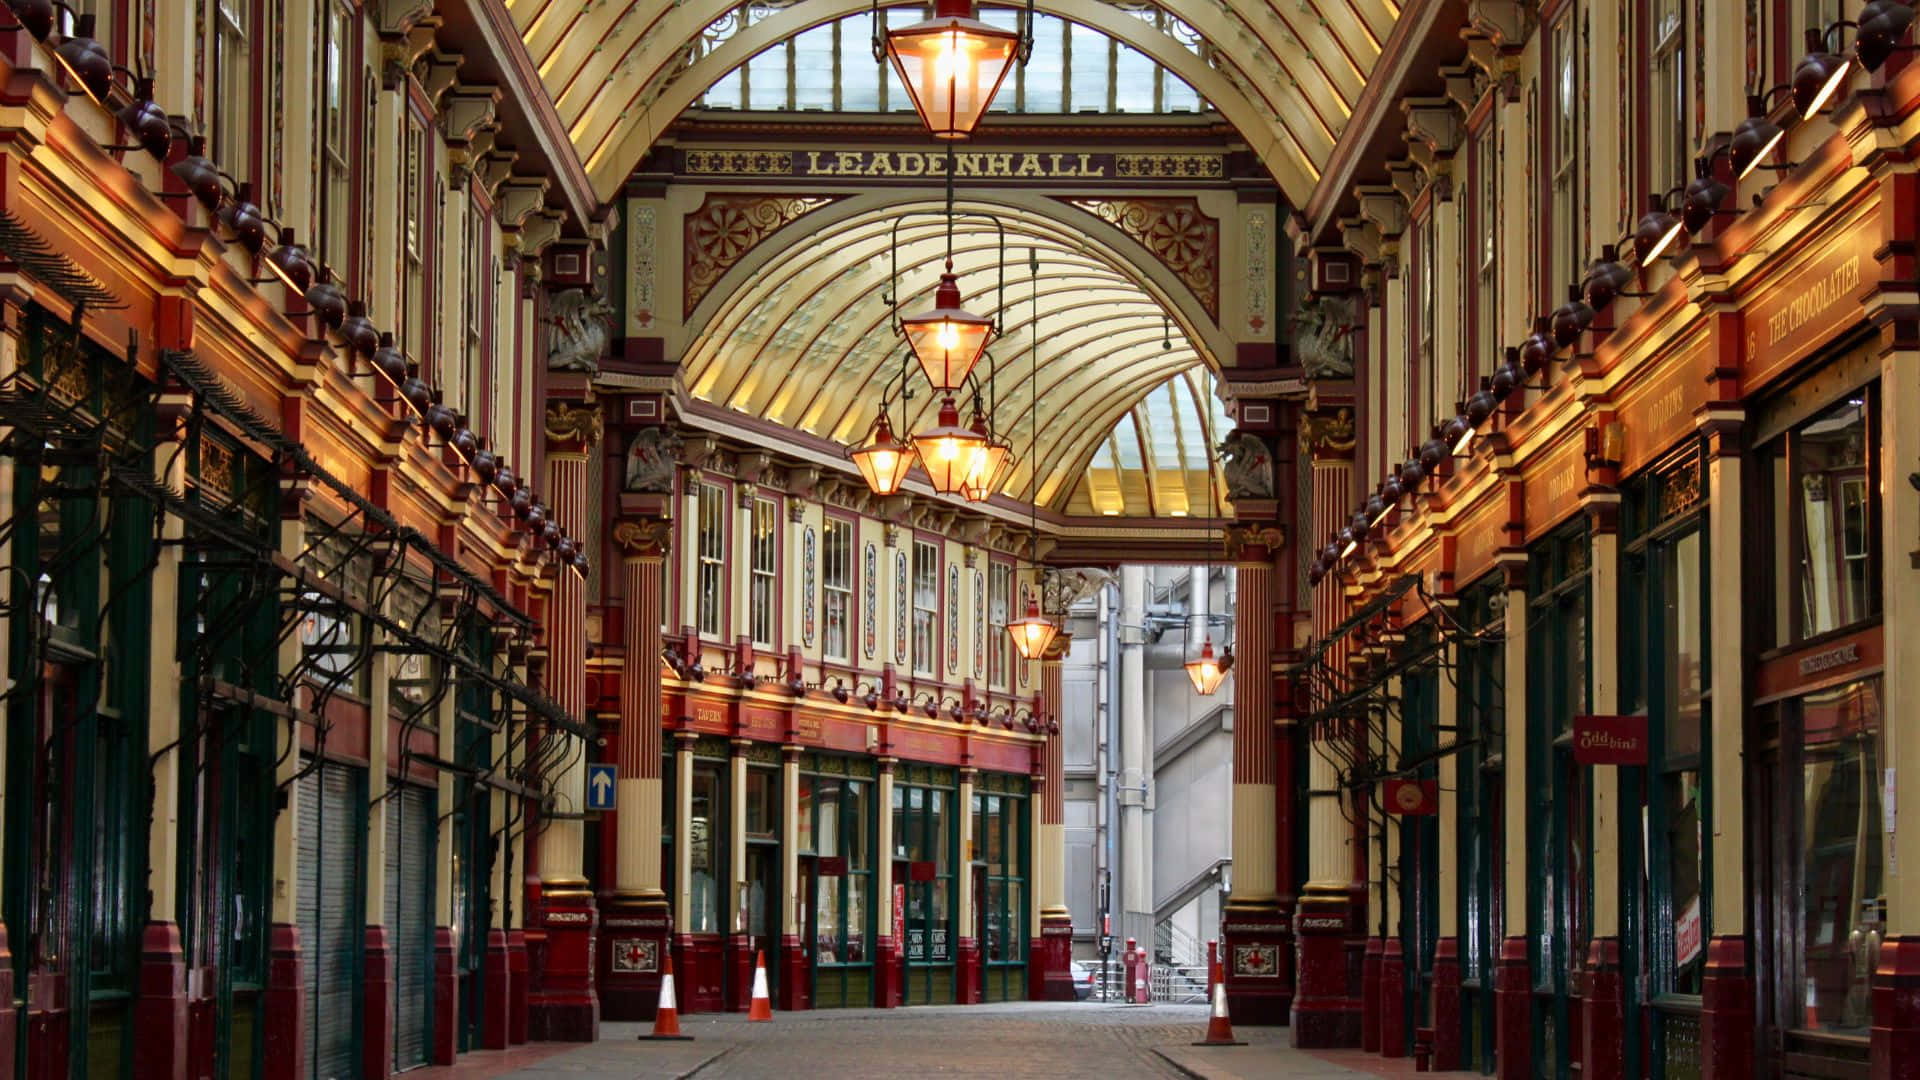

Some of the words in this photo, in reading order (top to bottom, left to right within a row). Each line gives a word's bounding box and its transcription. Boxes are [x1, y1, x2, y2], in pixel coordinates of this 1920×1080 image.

[807, 151, 1105, 177] LEADENHALL
[1767, 308, 1787, 347] THE
[1789, 255, 1861, 332] CHOCOLATIER
[697, 708, 722, 722] TAVERN
